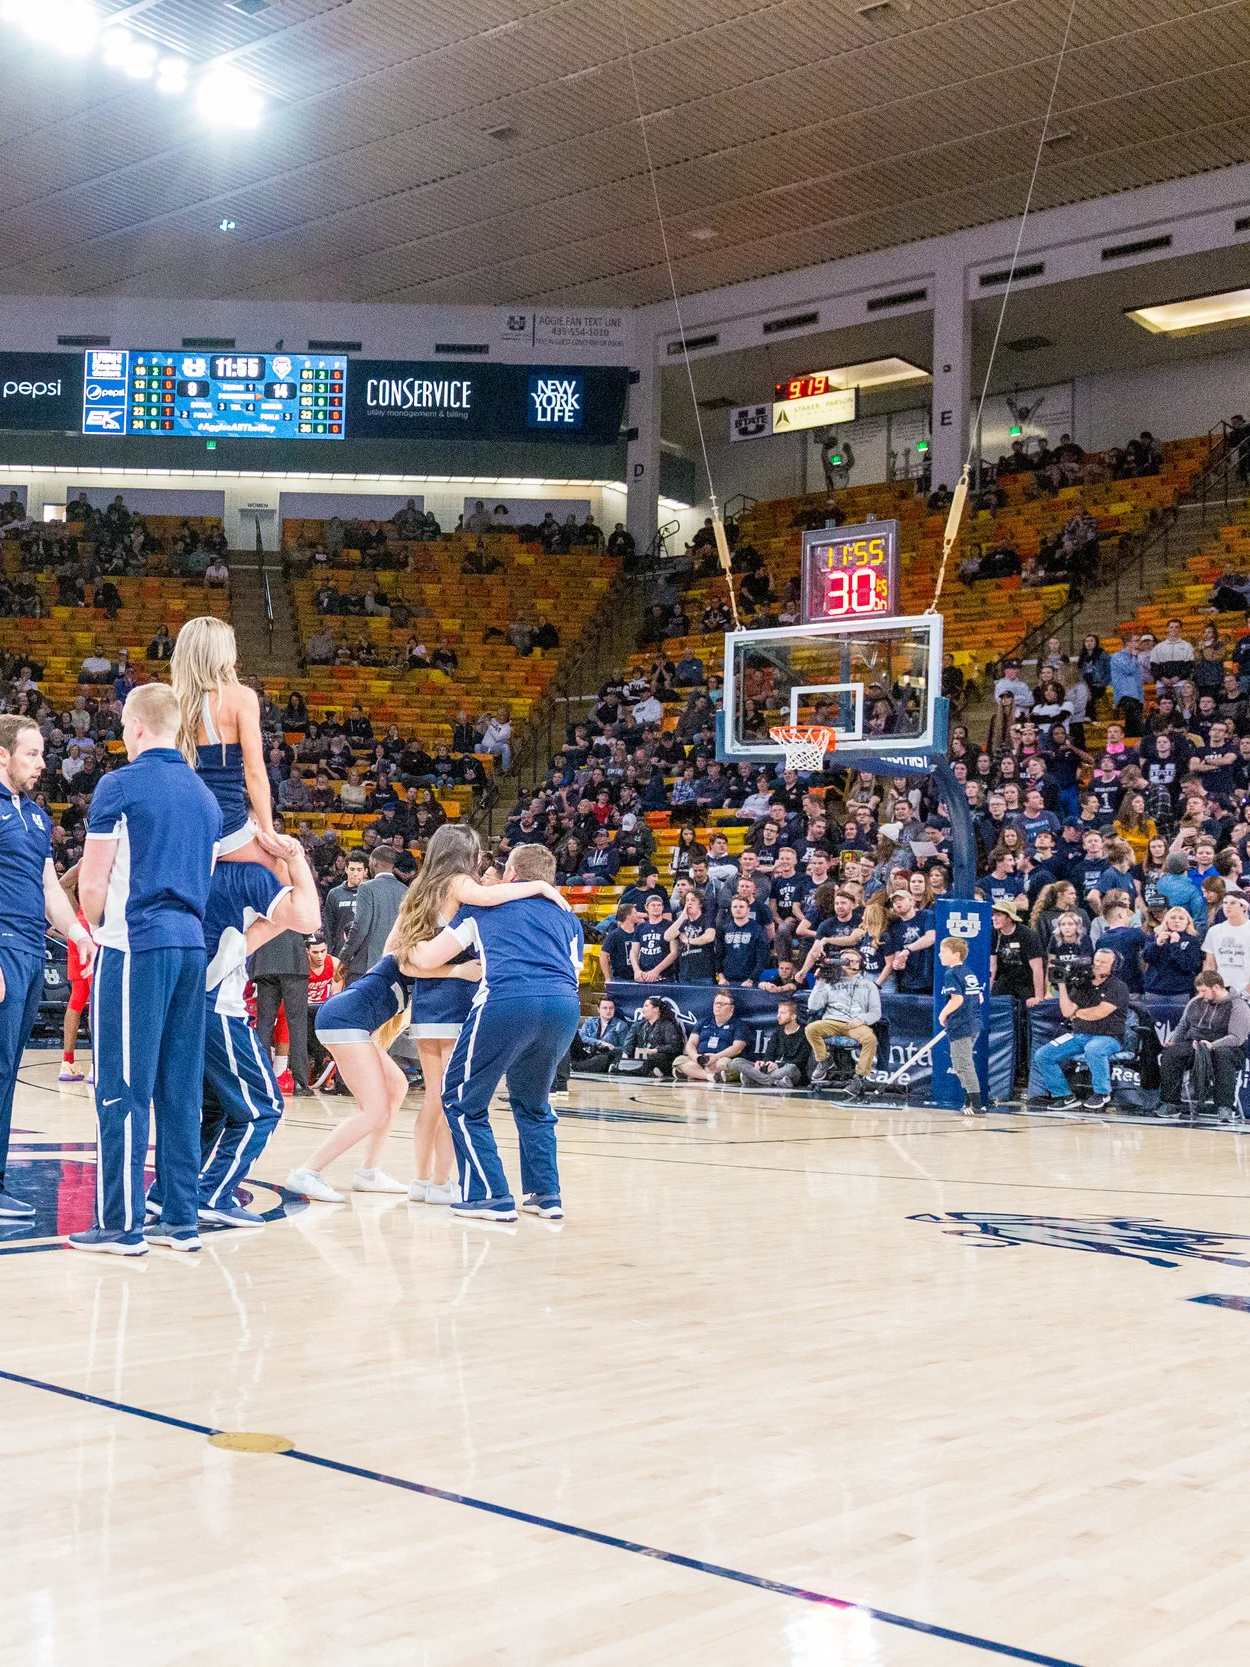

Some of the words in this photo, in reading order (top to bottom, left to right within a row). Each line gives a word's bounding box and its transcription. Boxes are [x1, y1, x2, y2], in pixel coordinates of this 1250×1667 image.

[215, 357, 259, 378] 11:55
[3, 379, 62, 399] pepsi
[272, 383, 288, 399] 14
[537, 380, 577, 395] NEW
[530, 393, 580, 409] YORK
[386, 410, 438, 419] management
[446, 410, 469, 420] billing
[536, 407, 575, 422] LIFE
[734, 414, 769, 429] STATE
[941, 410, 952, 426] E
[634, 463, 644, 477] D
[827, 539, 884, 568] 11:55
[827, 568, 876, 616] 30
[1100, 792, 1111, 809] 1
[642, 933, 662, 941] UTAH
[724, 931, 751, 944] USU
[640, 947, 662, 955] STATE
